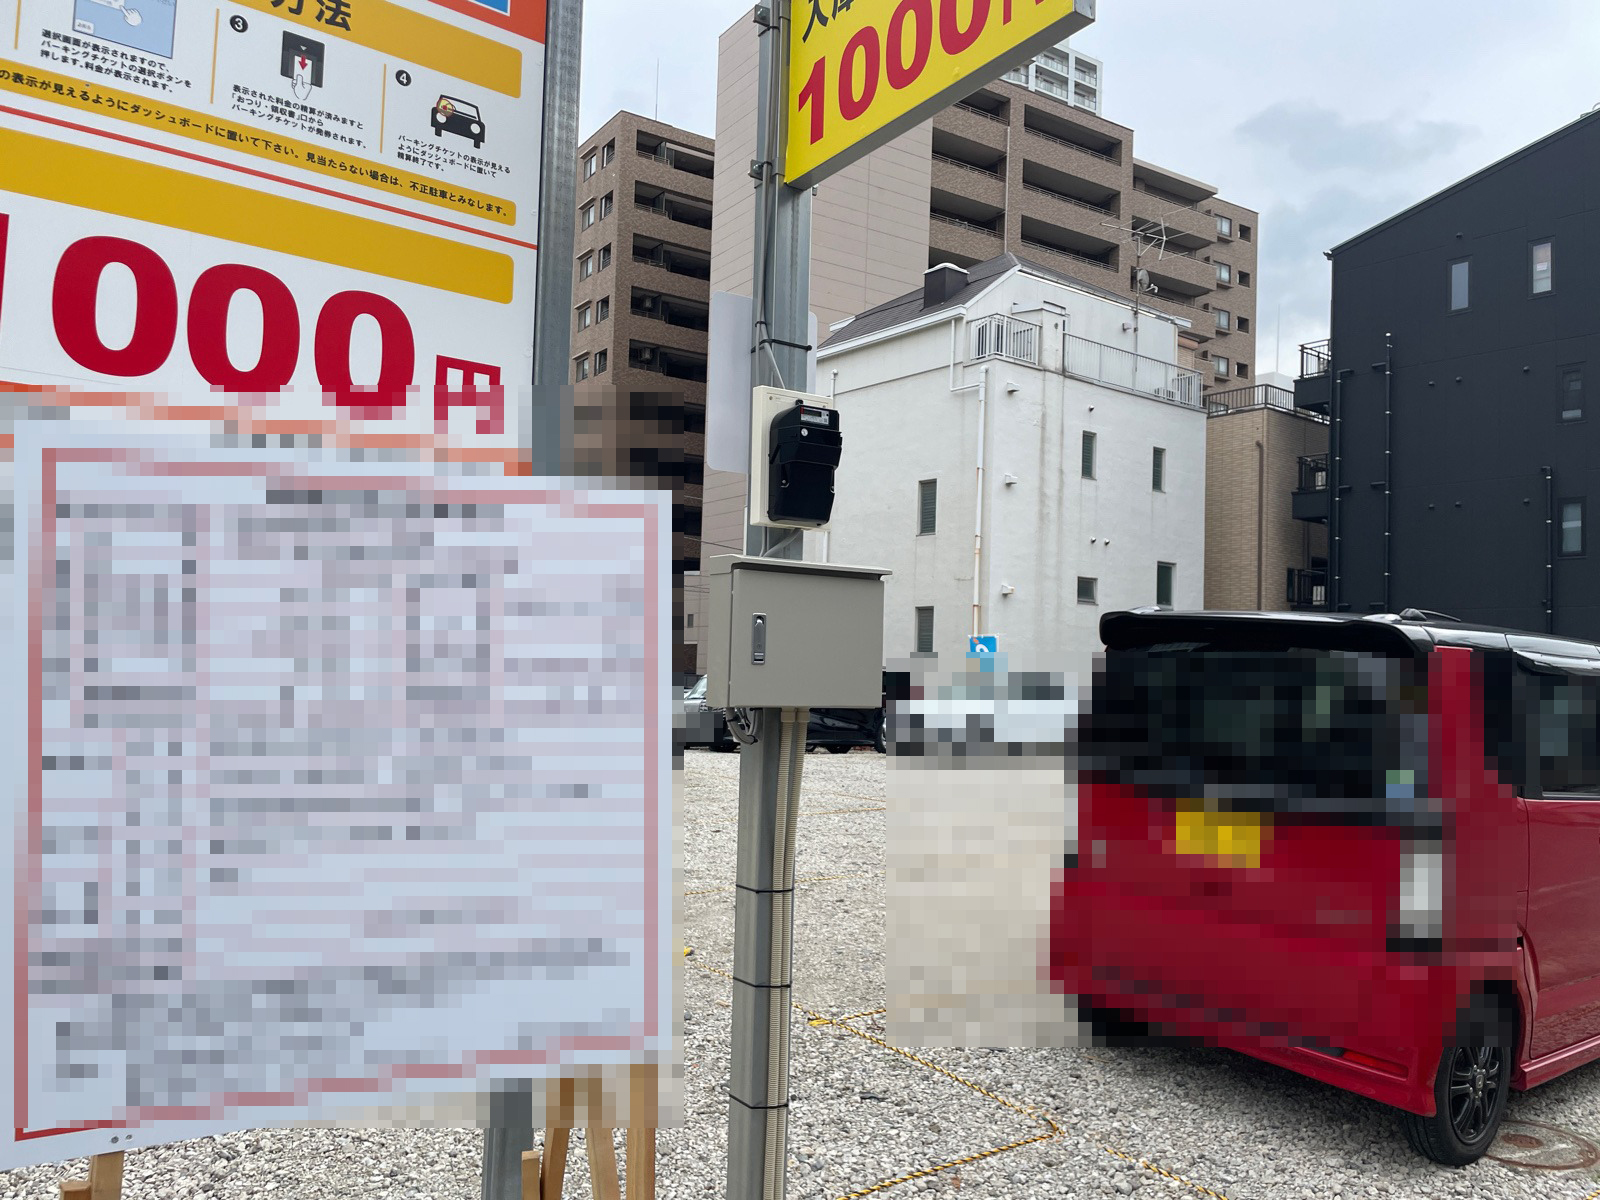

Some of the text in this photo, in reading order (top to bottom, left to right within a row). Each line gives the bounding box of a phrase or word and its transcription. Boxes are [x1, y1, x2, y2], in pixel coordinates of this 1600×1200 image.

[40, 49, 173, 93] 押します。料金が表示されます。
[41, 28, 170, 72] 選択画面が表示されますので、
[41, 40, 192, 88] パーキングチケットの選択ボタンを
[798, 0, 1045, 146] 1000
[231, 104, 367, 149] パーキングチケットが発券されます。
[232, 84, 364, 130] 表示された料金の精算が済みますと
[397, 143, 497, 178] ようにダッシュボードに置いて
[397, 151, 445, 172] 精算終了です。
[398, 134, 511, 174] パーキングチケットの表示が見える
[0, 211, 503, 434] 000円
